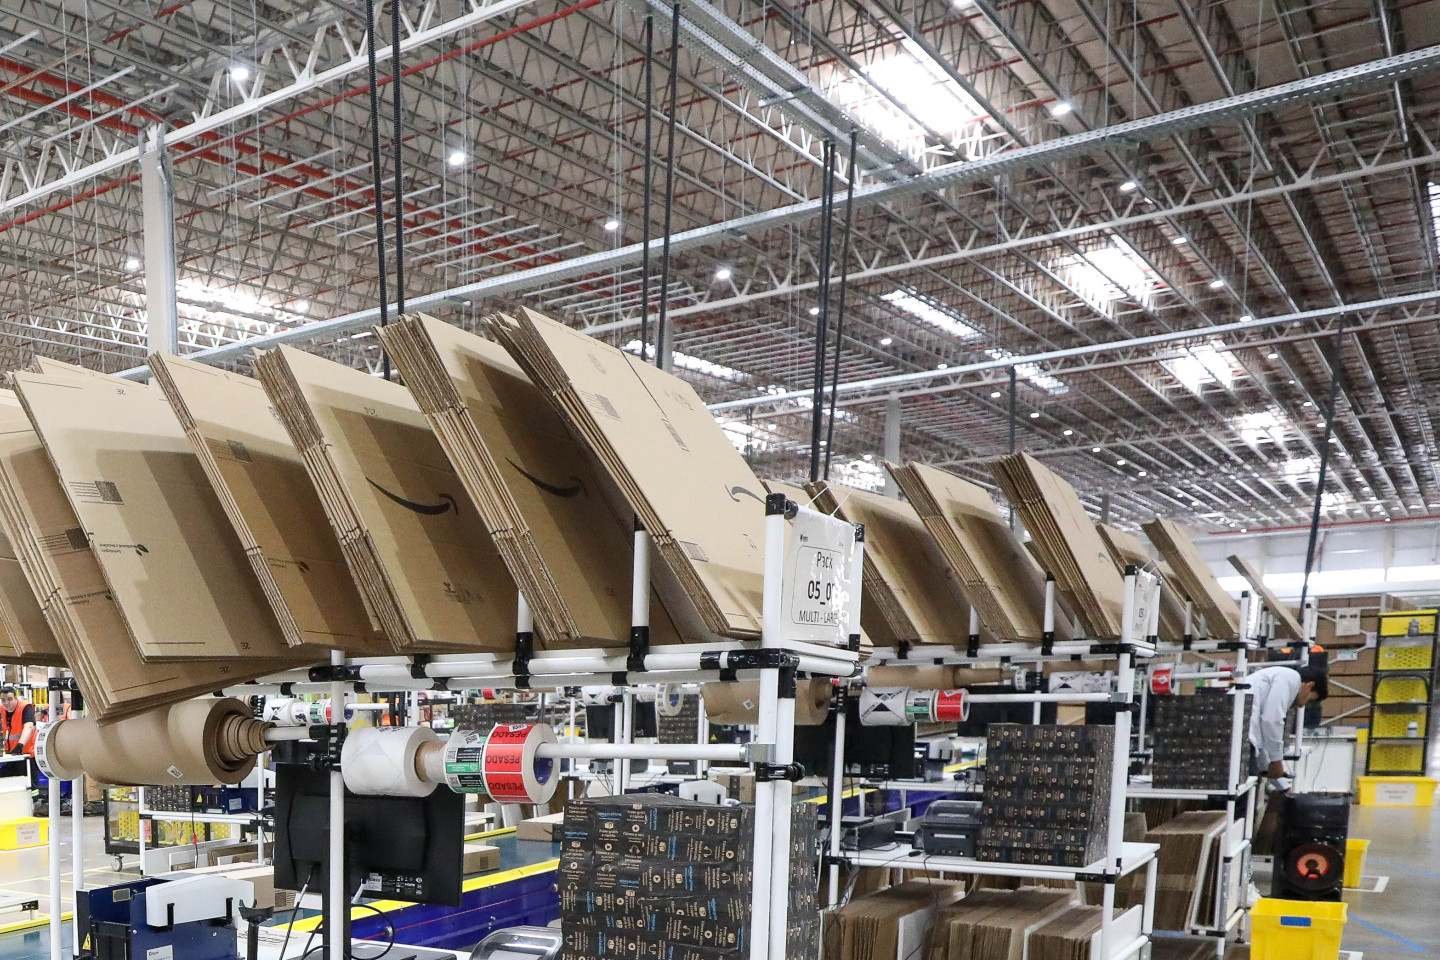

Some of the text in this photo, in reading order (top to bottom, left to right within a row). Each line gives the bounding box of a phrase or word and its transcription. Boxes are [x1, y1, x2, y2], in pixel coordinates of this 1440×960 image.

[816, 551, 833, 569] Pack
[807, 580, 835, 605] 05_0
[799, 610, 820, 624] MULTI
[492, 731, 527, 739] PESADO
[486, 755, 520, 764] PESADO
[489, 782, 523, 791] PESADO
